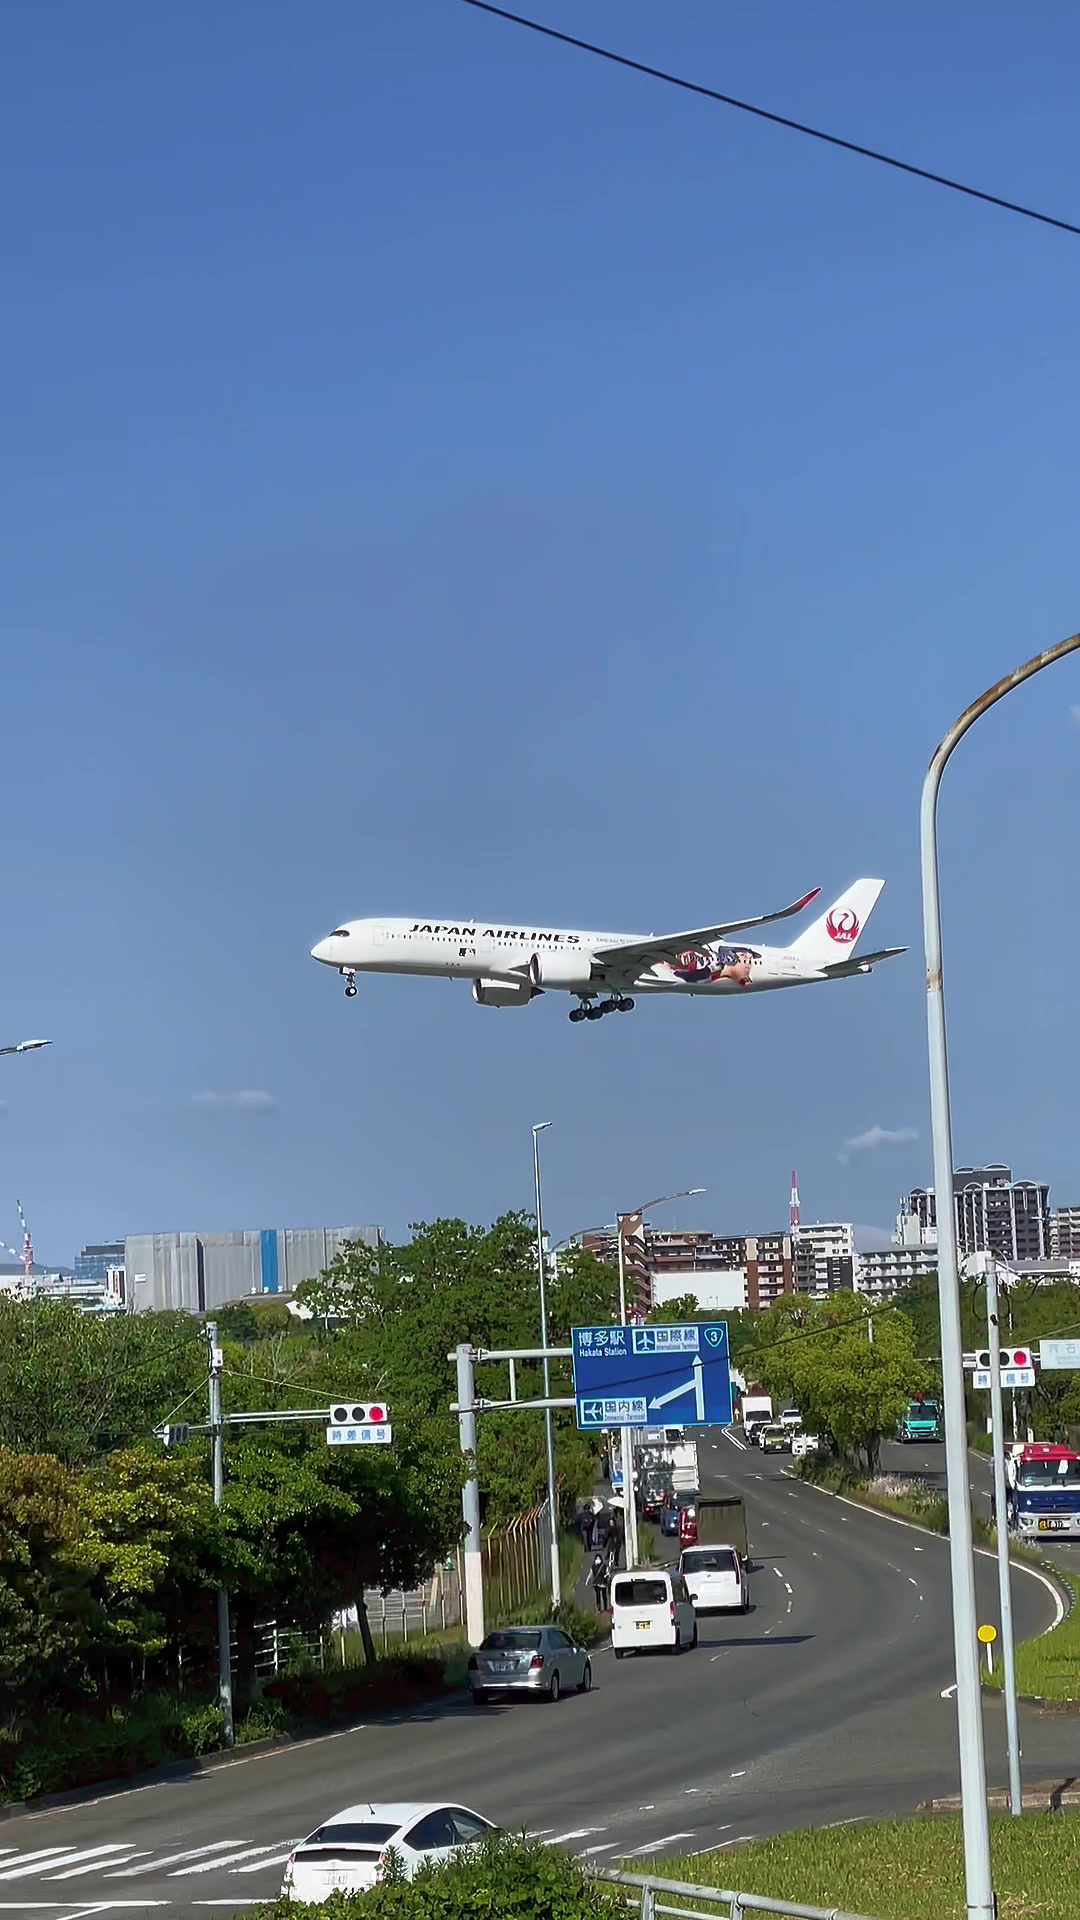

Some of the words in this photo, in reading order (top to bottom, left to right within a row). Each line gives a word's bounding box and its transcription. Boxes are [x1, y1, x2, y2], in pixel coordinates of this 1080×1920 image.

[409, 923, 477, 936] JAPAN
[482, 928, 580, 944] AIRLINES
[833, 931, 853, 940] JAL
[578, 1330, 626, 1347] 博多駅
[656, 1329, 696, 1342] 国際線
[710, 1331, 718, 1342] 3
[579, 1348, 603, 1357] Hakata
[604, 1347, 627, 1356] Station
[604, 1400, 644, 1412] 国内線
[332, 1428, 386, 1441] 時差信号
